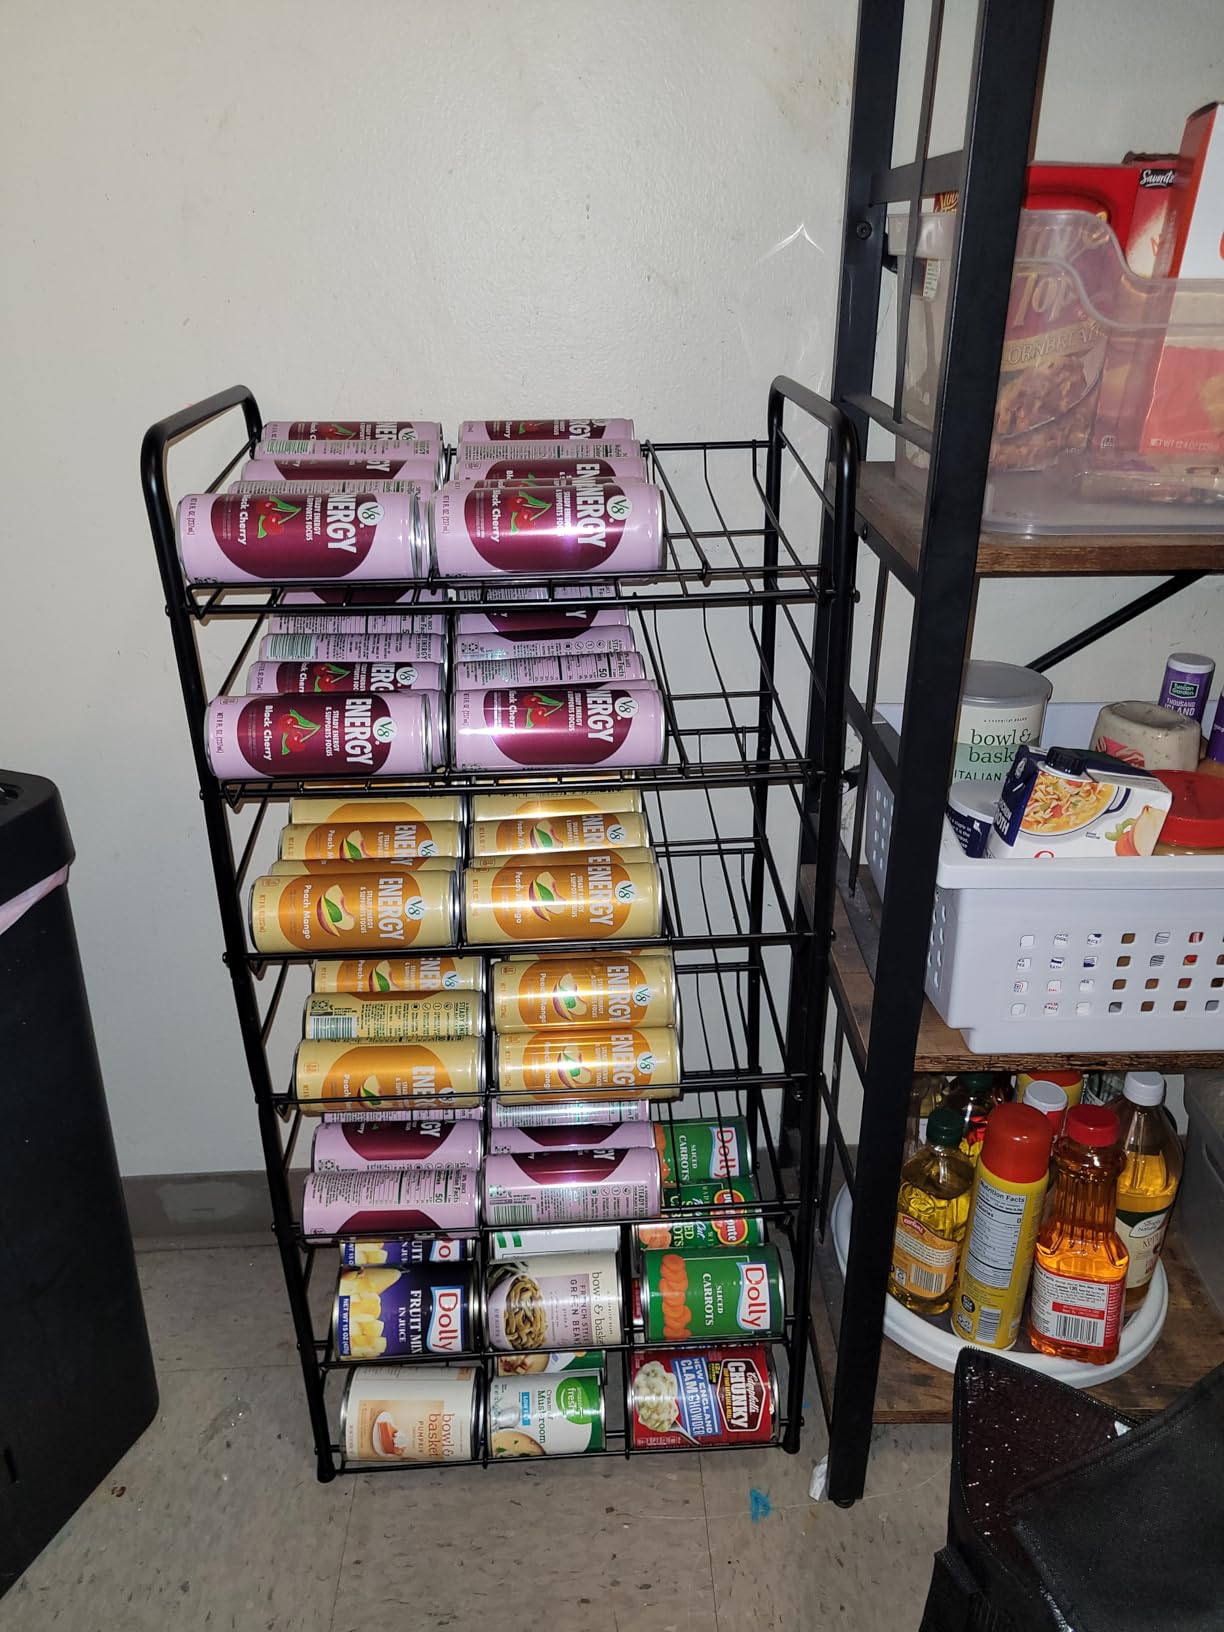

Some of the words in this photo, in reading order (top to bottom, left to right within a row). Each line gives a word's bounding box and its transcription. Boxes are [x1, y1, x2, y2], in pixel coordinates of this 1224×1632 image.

[375, 422, 396, 440] NER
[239, 494, 250, 509] lack
[491, 489, 501, 506] lack
[611, 499, 630, 515] V8
[313, 512, 321, 535] ENERGY
[326, 494, 357, 553] NERGY
[361, 505, 381, 521] V8
[576, 487, 606, 548] NERGY
[237, 511, 248, 545] Cherry
[305, 522, 314, 541] FOCUS
[490, 507, 501, 543] Cherry
[370, 663, 396, 691] NERG
[399, 669, 415, 681] V8
[598, 668, 607, 678] 50
[508, 690, 517, 703] lack
[618, 700, 636, 713] V8
[1167, 698, 1196, 708] THOUSAND
[263, 705, 273, 727] Black
[324, 711, 332, 738] SUPPORTS
[332, 710, 340, 729] STEADY
[567, 714, 575, 732] FOCUS
[575, 706, 583, 726] ENERGY
[586, 690, 613, 743] NERGY
[344, 698, 373, 765] ENERGY
[376, 721, 395, 737] V8
[971, 728, 1016, 746] bowl
[1019, 728, 1032, 743] &
[263, 729, 273, 761] Cherry
[324, 739, 332, 757] FOCUS
[332, 730, 340, 752] ENERGY
[968, 746, 1015, 764] bask
[954, 769, 1002, 781] ITALIAN
[327, 830, 335, 850] Peach
[394, 825, 417, 857] ENER
[608, 827, 624, 840] V8
[421, 843, 435, 857] V8
[514, 871, 522, 891] Peach
[618, 884, 635, 899] V8
[303, 885, 311, 908] Peach
[588, 866, 614, 926] ENERGY
[378, 877, 404, 940] ENERGY
[407, 900, 424, 916] V8
[303, 911, 311, 940] Mango
[420, 957, 441, 991] NER
[445, 974, 459, 987] V8
[607, 965, 632, 1023] ENERGY
[636, 988, 650, 1002] V8
[611, 1034, 636, 1086] ENERG
[640, 1055, 654, 1069] V8
[679, 1135, 689, 1181] CARROTS
[435, 1193, 443, 1203] 50
[1005, 1194, 1025, 1203] Facts
[411, 1240, 422, 1263] UIT
[591, 1271, 602, 1300] bow
[702, 1273, 714, 1326] CARROTS
[716, 1285, 724, 1314] SLICED
[742, 1267, 767, 1328] Dolly
[343, 1312, 349, 1323] WT
[398, 1307, 406, 1316] IN
[409, 1290, 422, 1331] FRUIT
[593, 1304, 604, 1315] &
[398, 1318, 406, 1343] JUICE
[432, 1292, 459, 1351] Dolly
[594, 1318, 606, 1345] baske
[342, 1332, 349, 1341] OZ
[410, 1334, 422, 1354] MIX
[567, 1387, 577, 1412] fresh
[680, 1359, 695, 1394] CLAM
[688, 1394, 705, 1436] CHOWDER
[692, 1358, 704, 1380] NEW
[699, 1382, 714, 1434] ENGLAND
[728, 1361, 748, 1429] CHUNKY
[428, 1413, 441, 1457] basket
[442, 1413, 455, 1448] bowl
[442, 1448, 454, 1457] &
